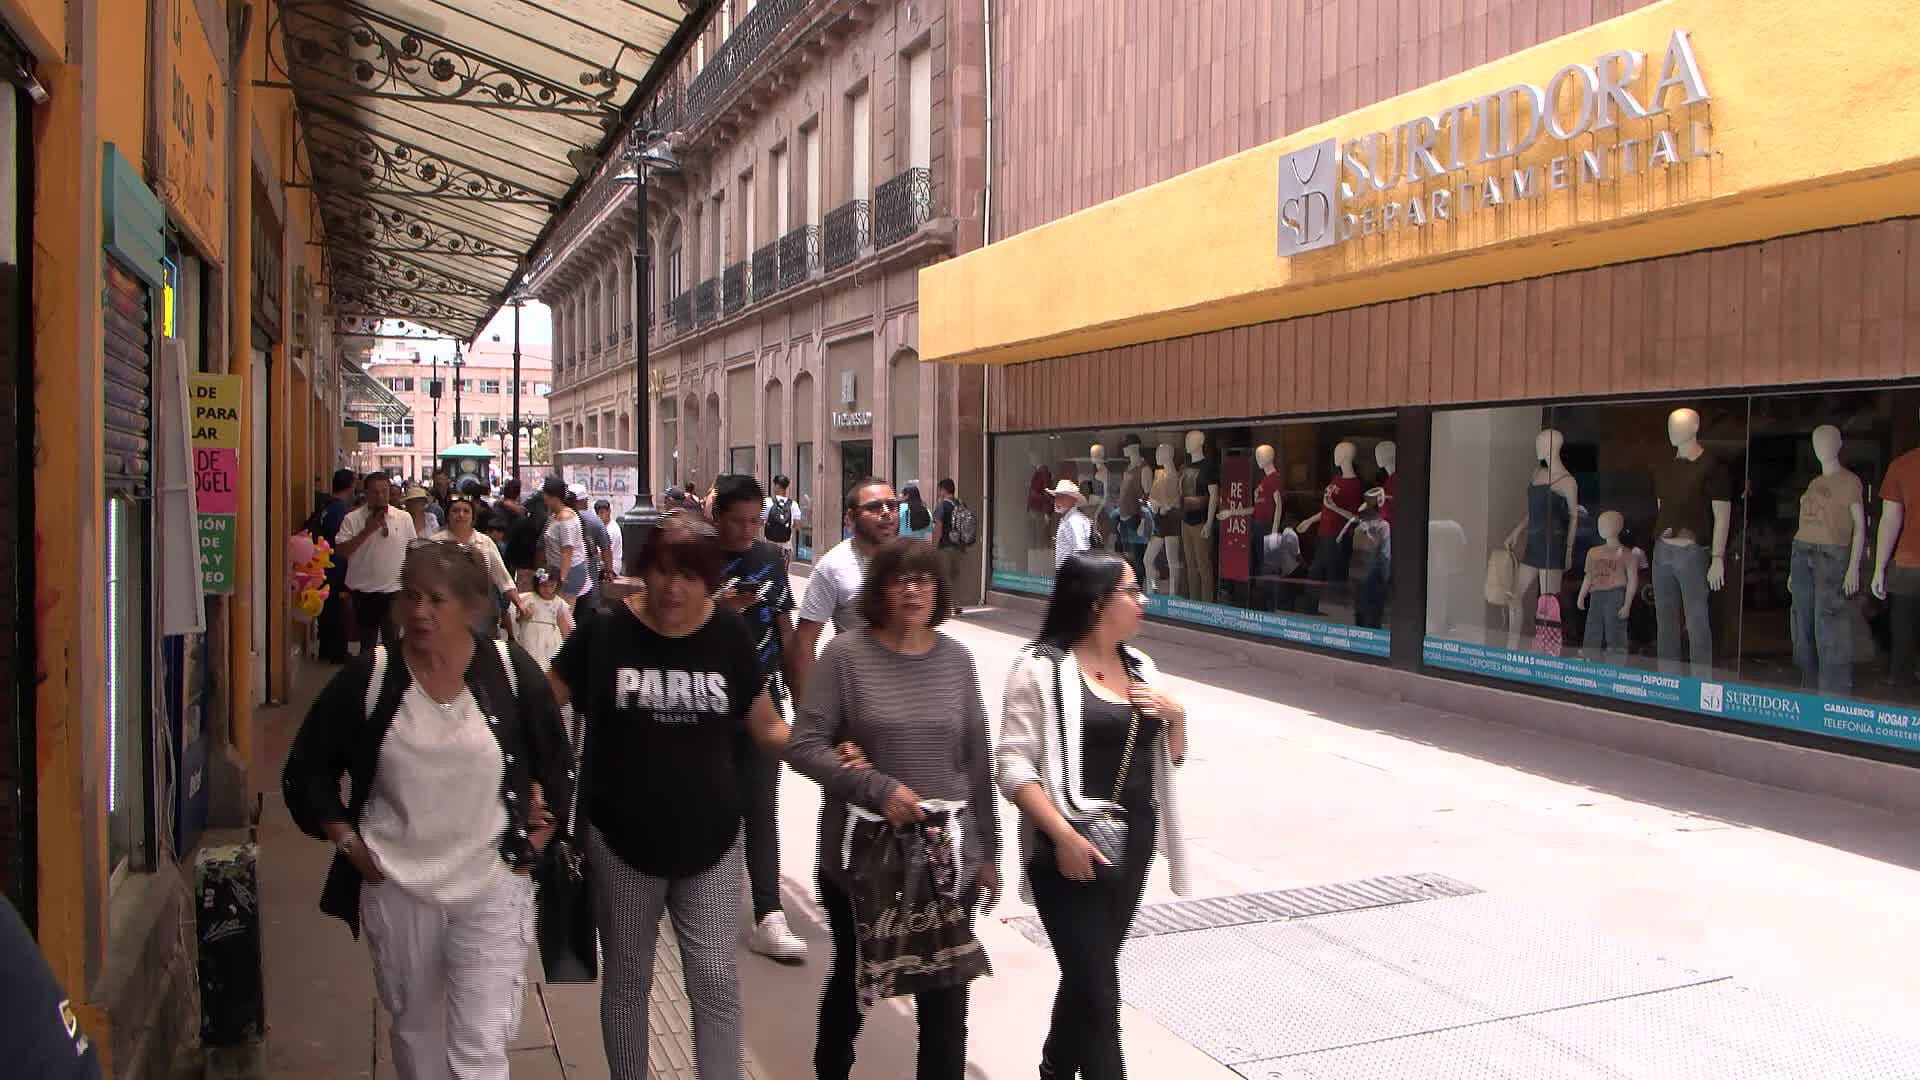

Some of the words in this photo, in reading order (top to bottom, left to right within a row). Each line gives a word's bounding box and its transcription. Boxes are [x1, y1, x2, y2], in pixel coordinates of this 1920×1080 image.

[1341, 28, 1712, 200] SURTIDORA
[1342, 118, 1713, 241] DEPARTAMENTAL
[1281, 190, 1329, 246] SD
[197, 386, 217, 398] DE
[196, 407, 238, 420] PARA
[197, 450, 220, 471] DE
[1230, 482, 1243, 498] RE
[1226, 519, 1247, 534] JAS
[201, 536, 220, 548] DE
[213, 554, 223, 565] Y
[1506, 652, 1535, 665] DAMAS
[1642, 674, 1680, 689] DEPORTES
[616, 667, 730, 715] PARIS
[1726, 690, 1800, 714] SURTIDORA
[1823, 703, 1875, 719] CABALLEROS
[1878, 711, 1908, 728] HOGAR
